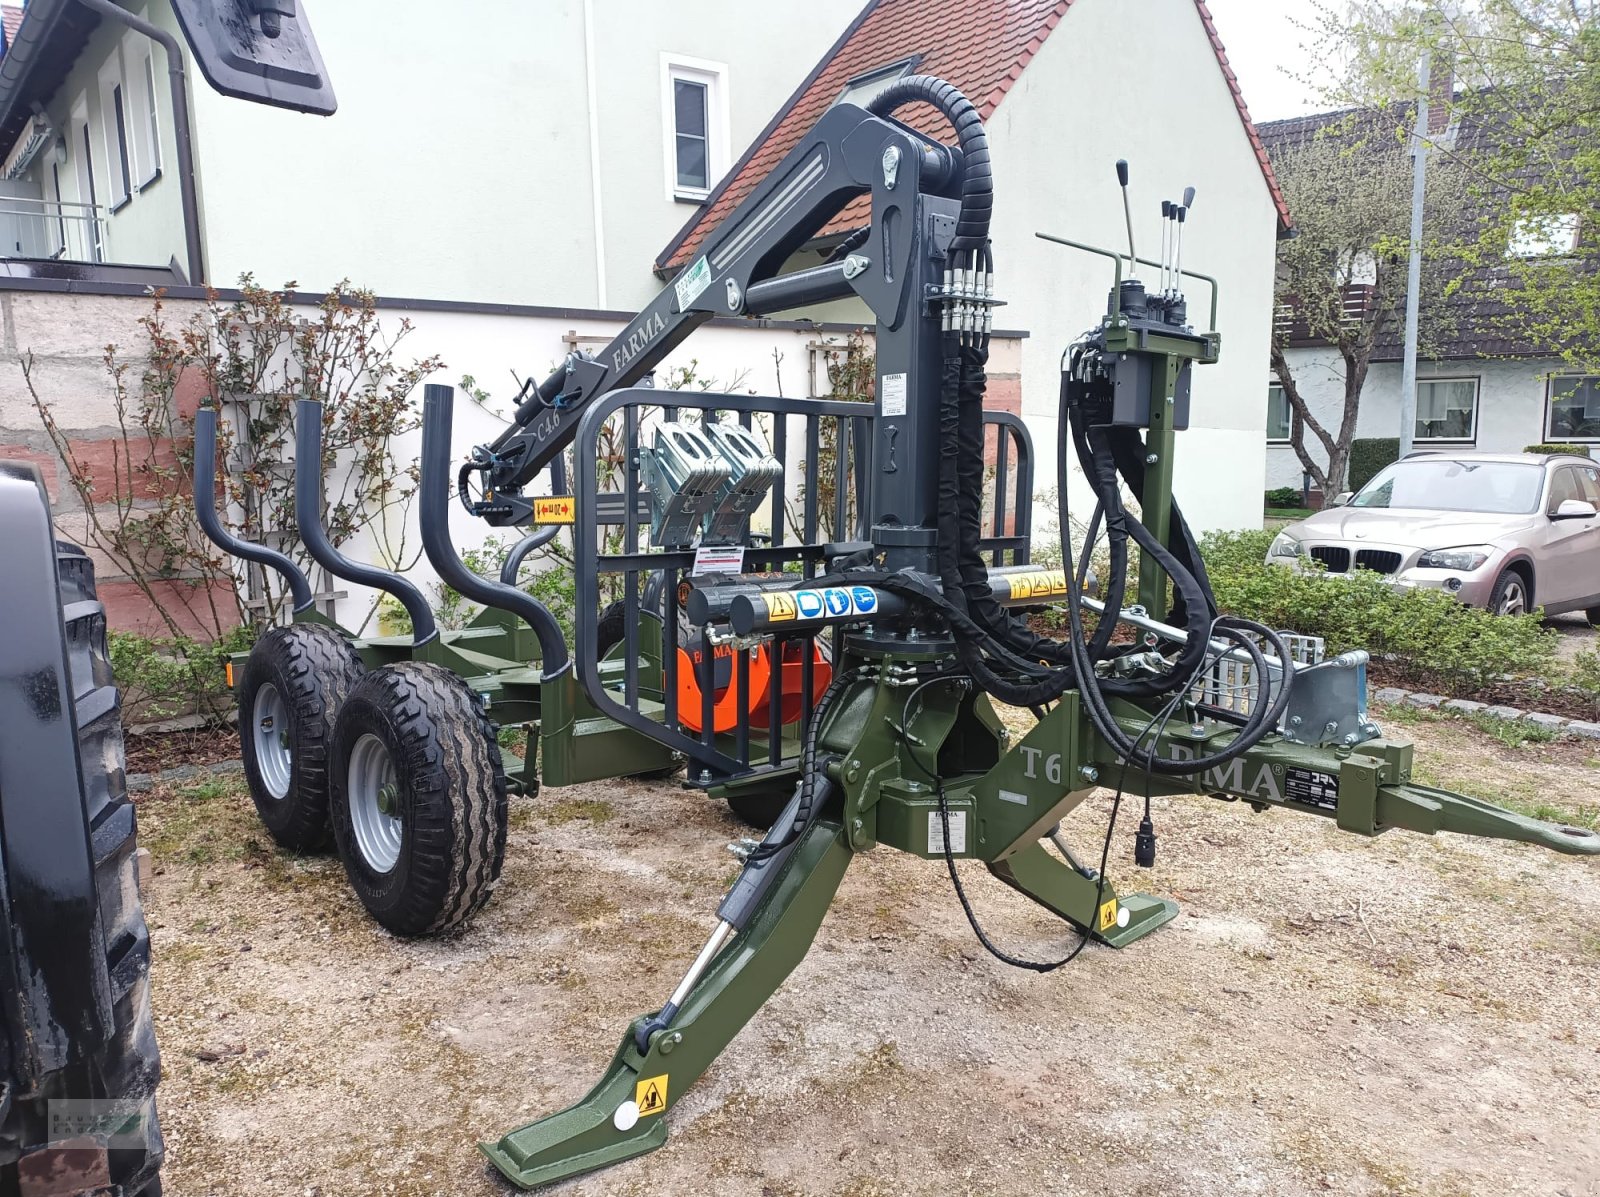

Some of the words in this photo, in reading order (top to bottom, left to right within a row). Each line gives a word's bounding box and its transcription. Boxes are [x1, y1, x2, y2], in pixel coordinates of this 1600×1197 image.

[612, 311, 666, 374] FARMA
[537, 408, 561, 442] C4.6
[1019, 745, 1062, 784] T6
